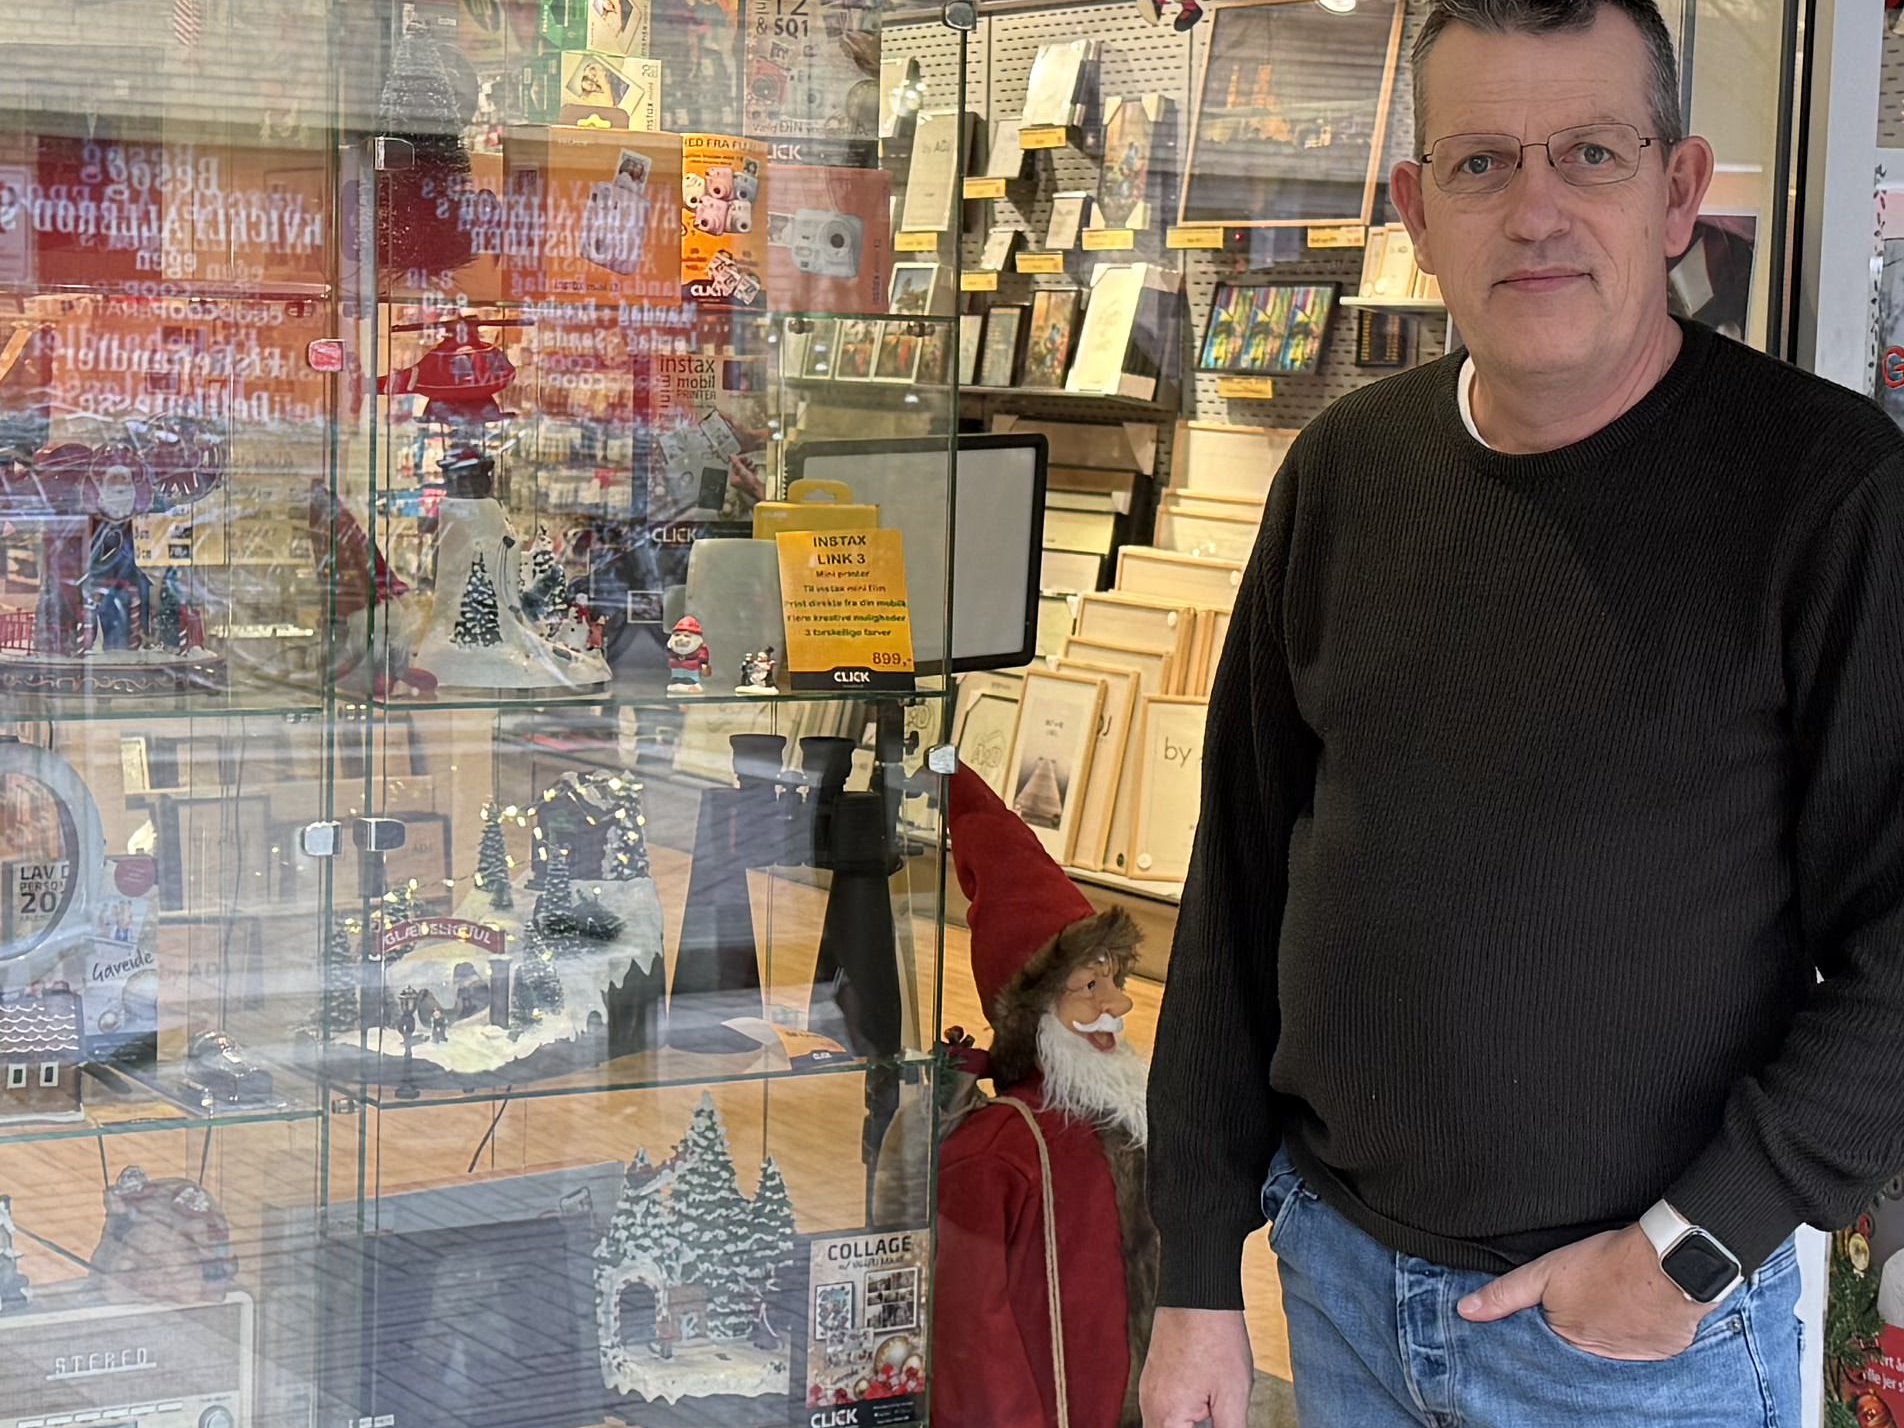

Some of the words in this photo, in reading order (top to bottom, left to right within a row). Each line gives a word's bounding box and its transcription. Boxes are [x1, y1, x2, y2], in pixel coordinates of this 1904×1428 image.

[774, 18, 809, 38] SQ1
[660, 354, 716, 374] instax
[677, 375, 716, 390] mobil
[652, 527, 697, 543] CLICK
[813, 535, 867, 548] INSTAX
[817, 554, 852, 565] LINK
[857, 554, 866, 565] 3
[872, 652, 912, 666] 899,-
[834, 672, 871, 683] CLICK
[1163, 736, 1192, 768] by
[20, 866, 55, 881] LAV
[92, 948, 155, 983] Gaveide
[827, 1235, 912, 1261] COLLAGE
[56, 1347, 147, 1375] STEREO
